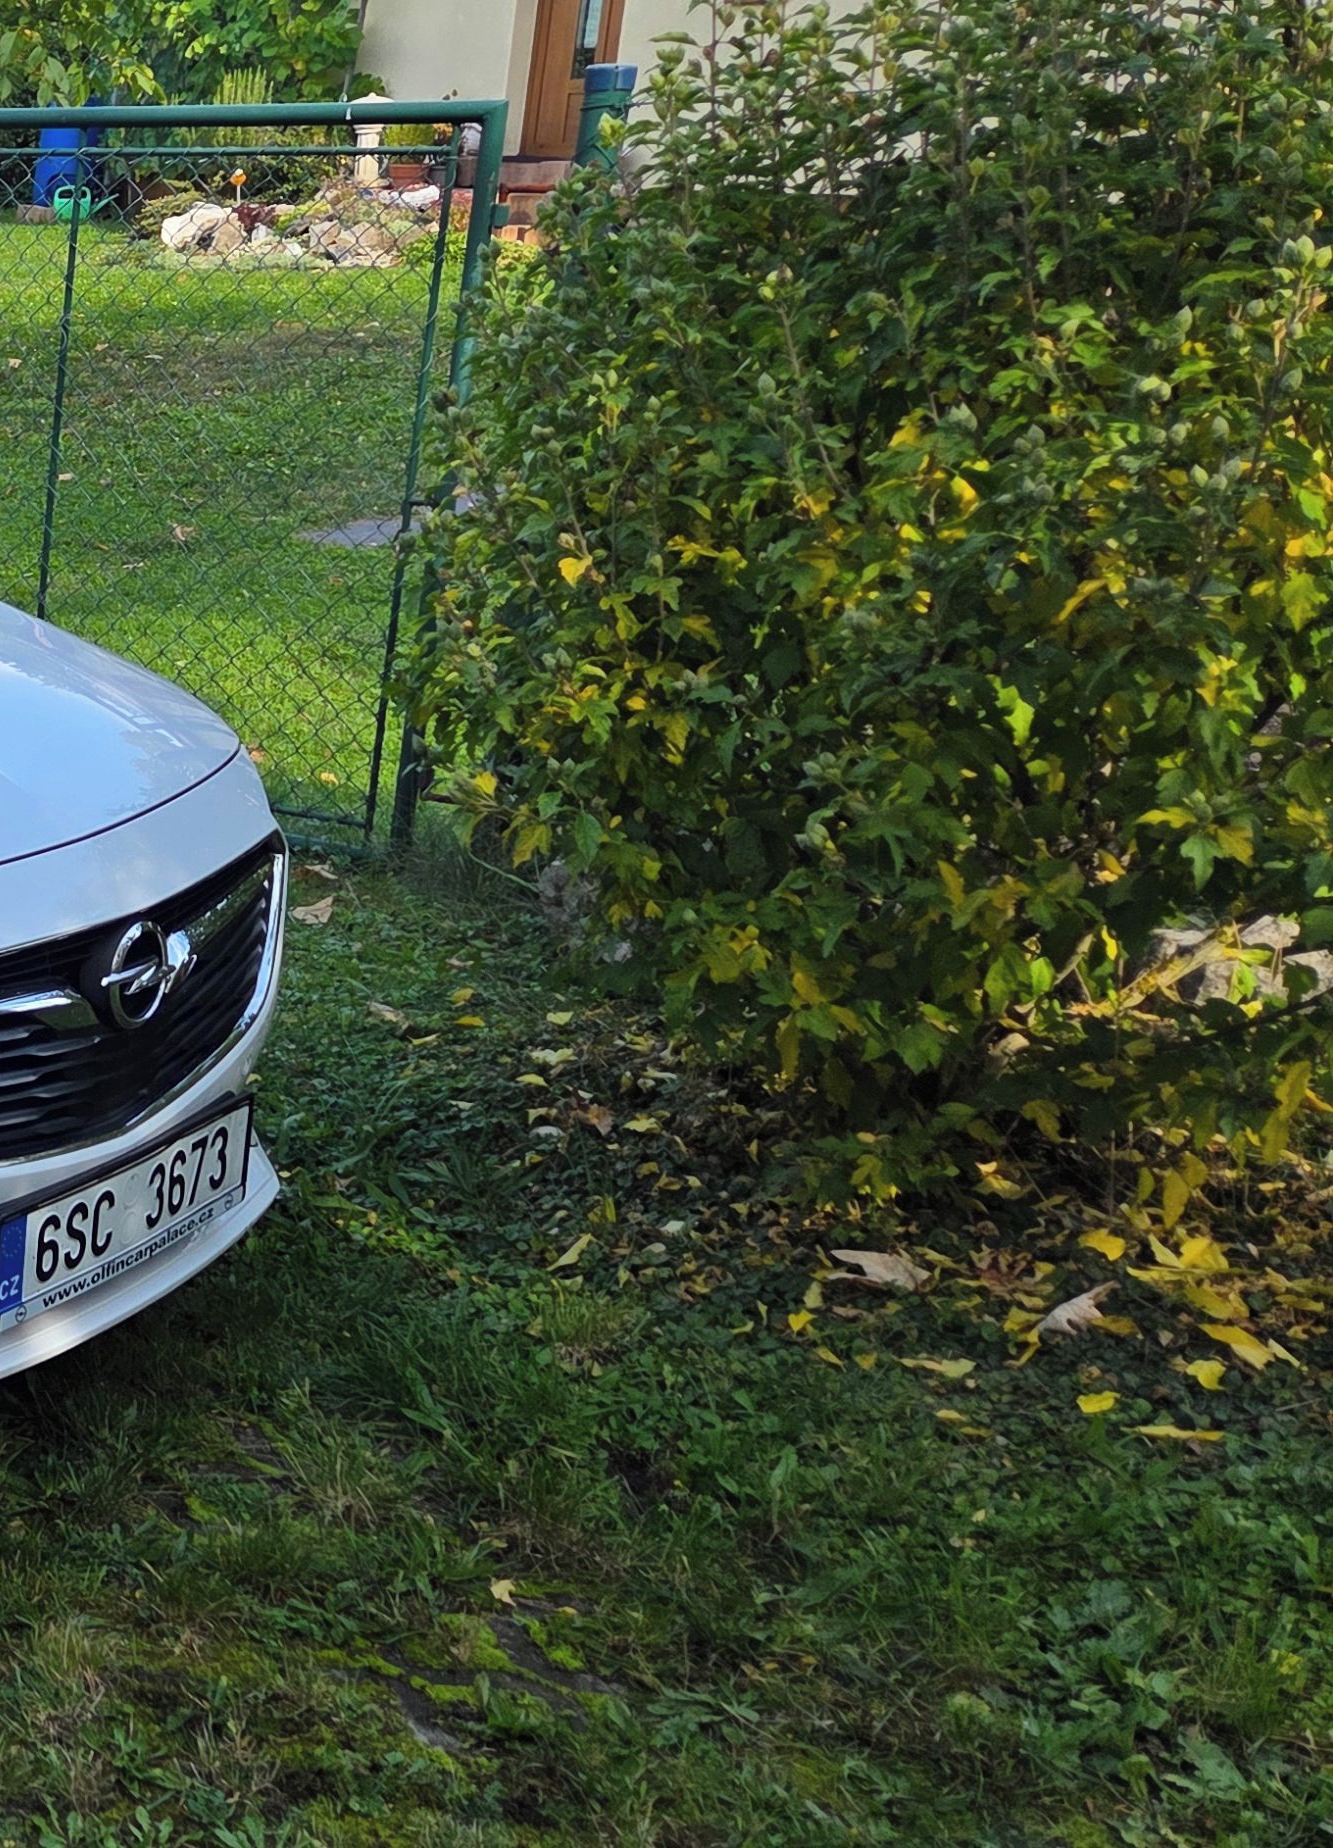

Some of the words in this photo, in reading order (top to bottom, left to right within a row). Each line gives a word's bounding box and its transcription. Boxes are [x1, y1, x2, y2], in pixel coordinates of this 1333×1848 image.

[35, 1190, 115, 1283] 6SC
[146, 1126, 229, 1230] 3673
[0, 1274, 20, 1301] CZ
[42, 1206, 215, 1308] www.olfincarpalace.cz
